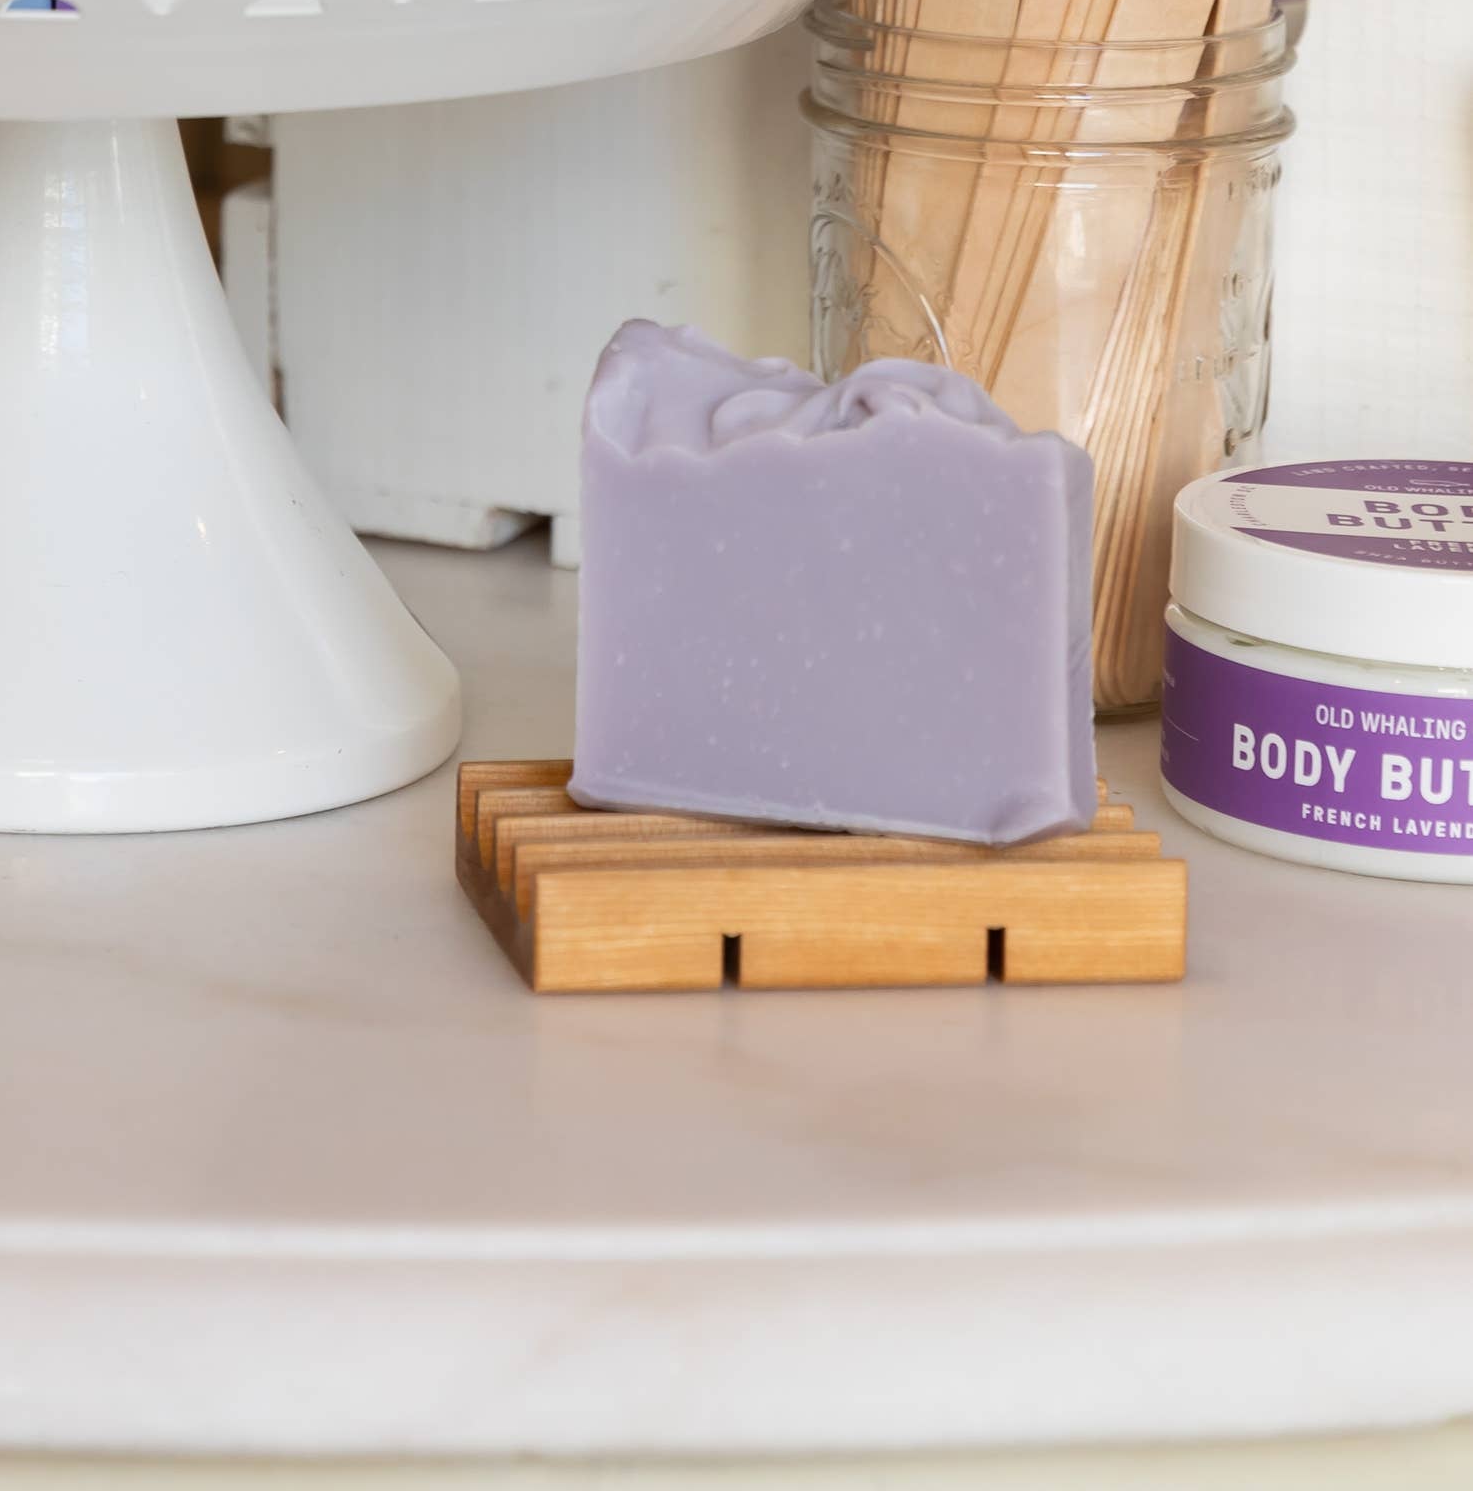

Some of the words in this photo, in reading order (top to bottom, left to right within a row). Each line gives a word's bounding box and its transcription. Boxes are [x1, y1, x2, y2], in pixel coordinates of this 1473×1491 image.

[1316, 704, 1353, 730] OLD
[1360, 711, 1466, 741] WHALING
[1232, 723, 1356, 793] BODY
[1302, 803, 1381, 831] FRENCH
